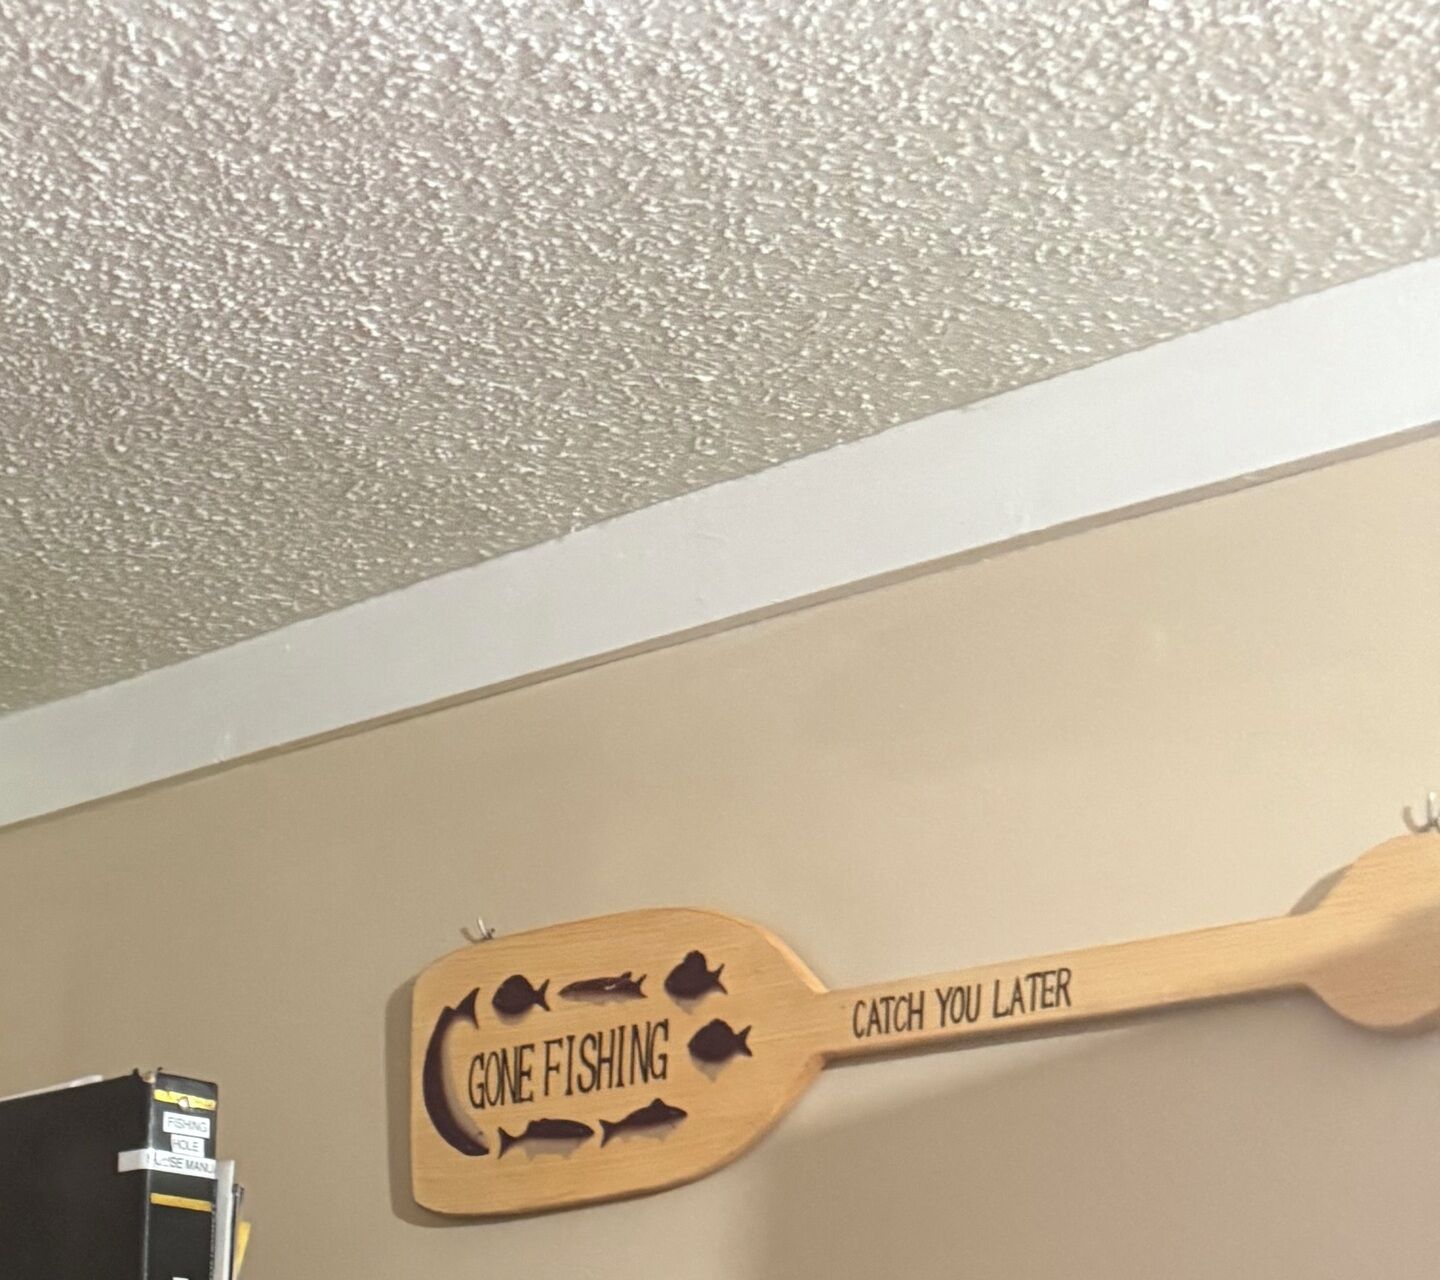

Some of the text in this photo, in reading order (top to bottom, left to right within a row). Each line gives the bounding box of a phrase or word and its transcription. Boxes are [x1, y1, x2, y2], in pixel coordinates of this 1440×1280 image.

[853, 967, 1072, 1038] CATCH YOU LATER
[468, 1018, 669, 1109] GONE FISHING
[167, 1116, 207, 1133] FISHING
[173, 1140, 199, 1152] HOLE
